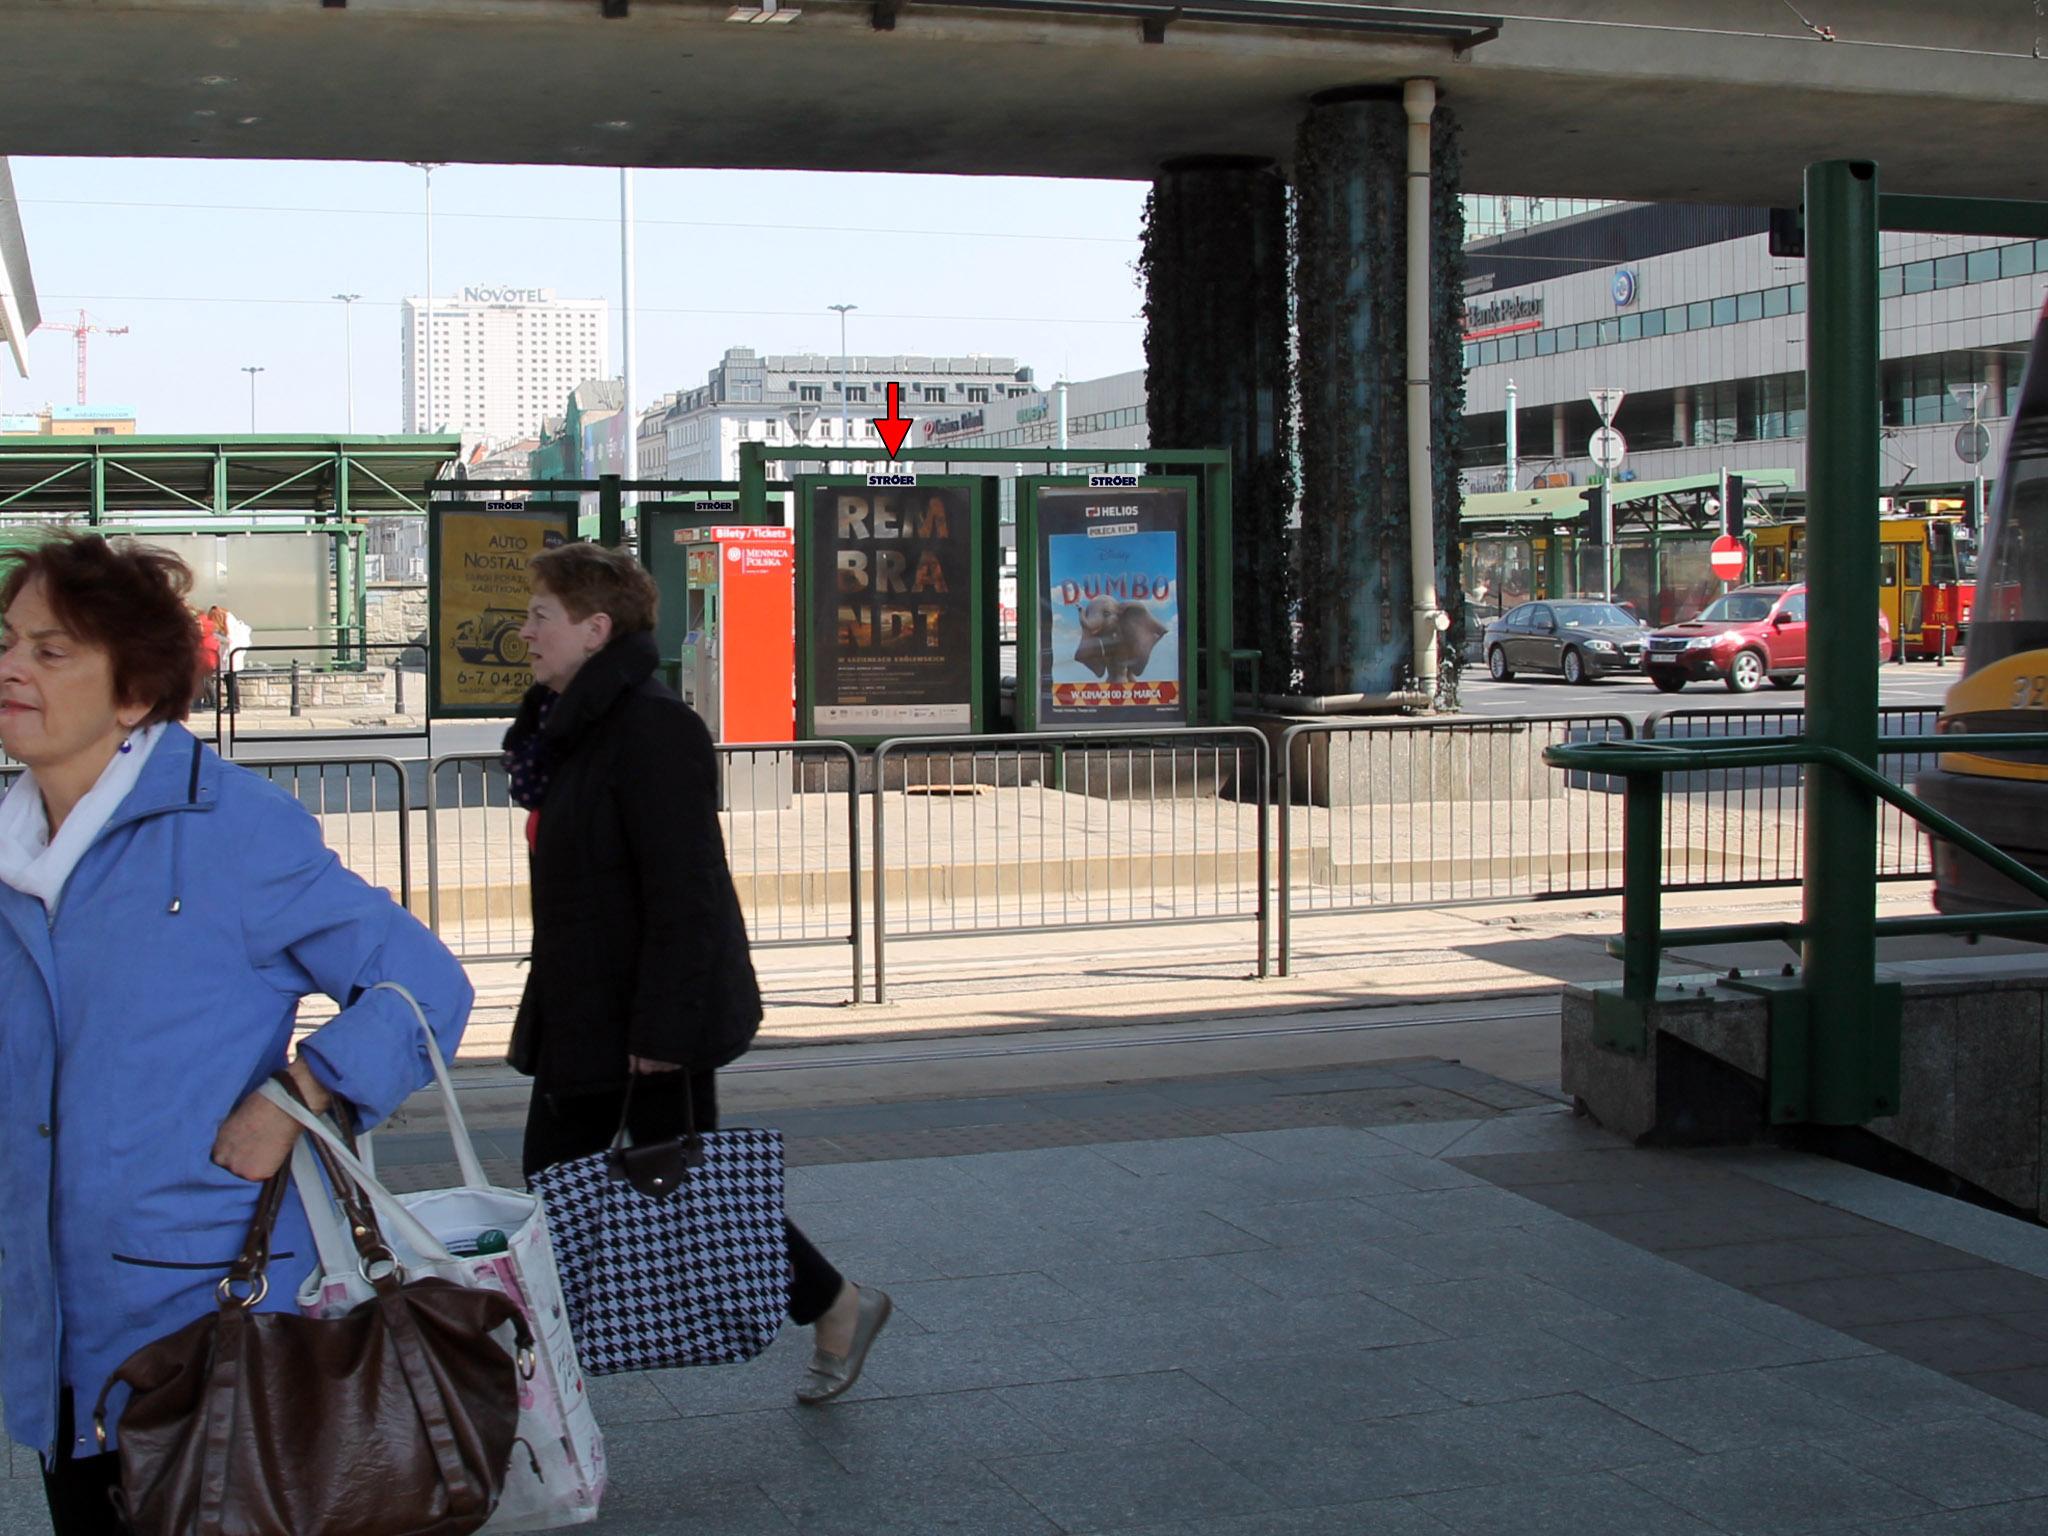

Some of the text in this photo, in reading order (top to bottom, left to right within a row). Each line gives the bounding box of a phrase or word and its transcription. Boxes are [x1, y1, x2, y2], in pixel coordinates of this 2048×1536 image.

[464, 287, 548, 303] NOVOTEL
[1468, 295, 1540, 327] Bank Pekao
[837, 496, 949, 540] REM
[1102, 505, 1139, 517] HELIOS
[716, 528, 745, 540] Bilety
[753, 528, 787, 538] Tickets
[1089, 524, 1135, 537] POLECA FILM
[489, 535, 528, 550] AUTO
[746, 549, 788, 557] MENNICA
[746, 558, 781, 567] POLSKA
[837, 550, 949, 593] BRA
[1061, 573, 1169, 605] DUMBO
[837, 604, 945, 647] NDT
[1133, 689, 1161, 698] MARCA
